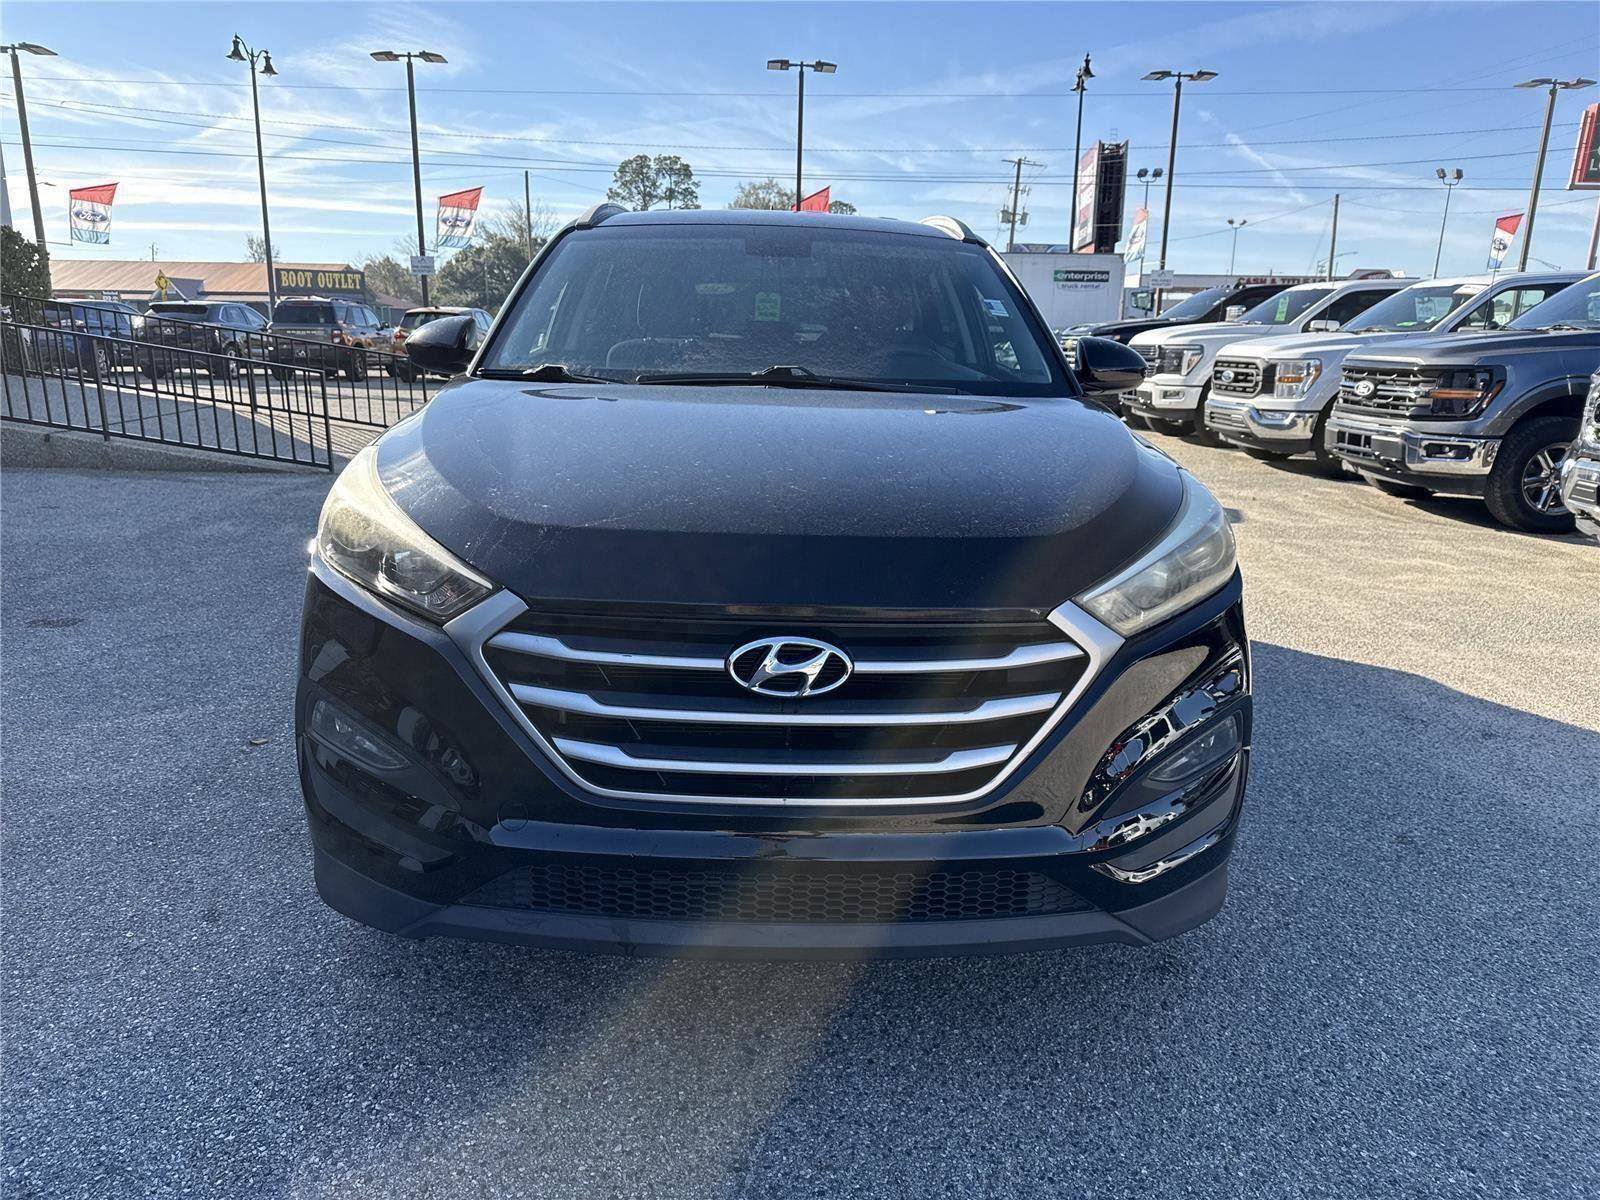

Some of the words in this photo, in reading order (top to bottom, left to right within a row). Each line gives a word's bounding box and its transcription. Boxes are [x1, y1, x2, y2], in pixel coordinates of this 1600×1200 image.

[280, 270, 313, 288] BOOT
[317, 272, 361, 289] OUTLET
[1054, 271, 1109, 281] enterprise
[1238, 277, 1267, 285] CASH
[1269, 277, 1277, 285] &
